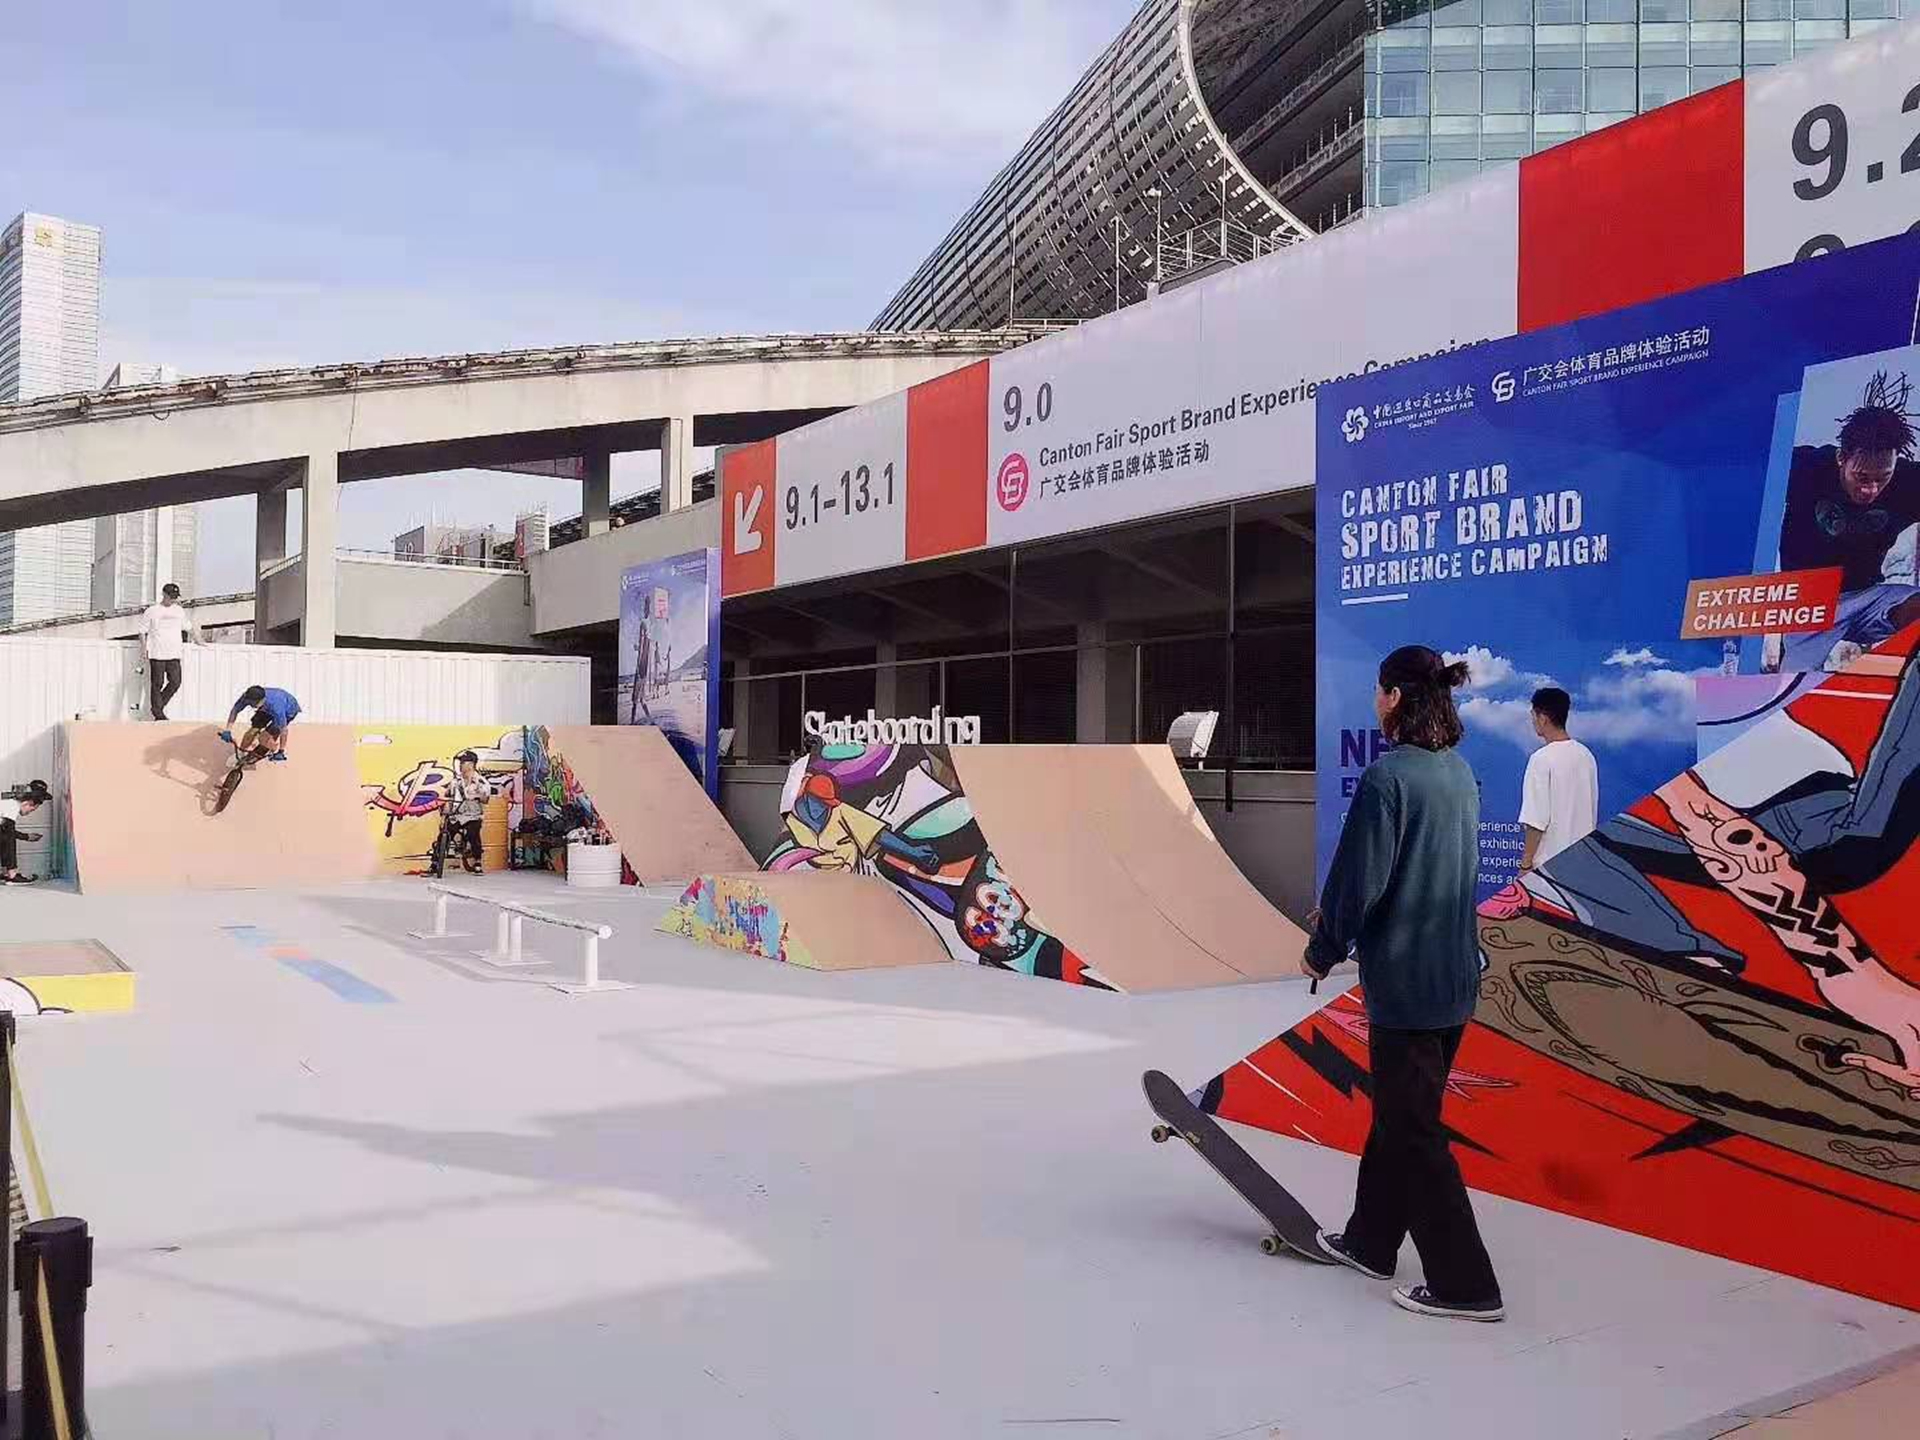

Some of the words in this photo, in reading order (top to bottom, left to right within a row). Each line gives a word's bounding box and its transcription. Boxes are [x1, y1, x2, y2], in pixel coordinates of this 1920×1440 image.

[1523, 326, 1710, 386] 广交会体育品牌体验活动
[1523, 385, 1551, 397] CANTON
[1553, 381, 1567, 391] FAIR
[1569, 375, 1592, 387] SPORT
[1594, 369, 1619, 382] BRAND
[1621, 360, 1664, 376] EXPERIENCE
[1665, 350, 1709, 366] CAMPAIGN
[1003, 382, 1052, 432] 9.0
[1040, 442, 1092, 467] Canton
[1096, 429, 1125, 453] Fair
[1129, 416, 1177, 446] Sport
[1181, 397, 1236, 432] Brand
[785, 462, 895, 530] 9.1-13.1
[1040, 439, 1210, 499] 广交会体育品牌体验活动
[1341, 476, 1437, 518] CANTON
[1448, 463, 1508, 502] FAIR
[1340, 510, 1441, 560] SPORT
[1456, 490, 1583, 546] BRAND
[1340, 552, 1462, 590] EXPERIENCE
[1471, 534, 1608, 576] CAMPAIGN
[1693, 605, 1826, 631] CHALLENGE
[1696, 583, 1799, 608] EXTREME
[804, 705, 981, 745] Skateboardng
